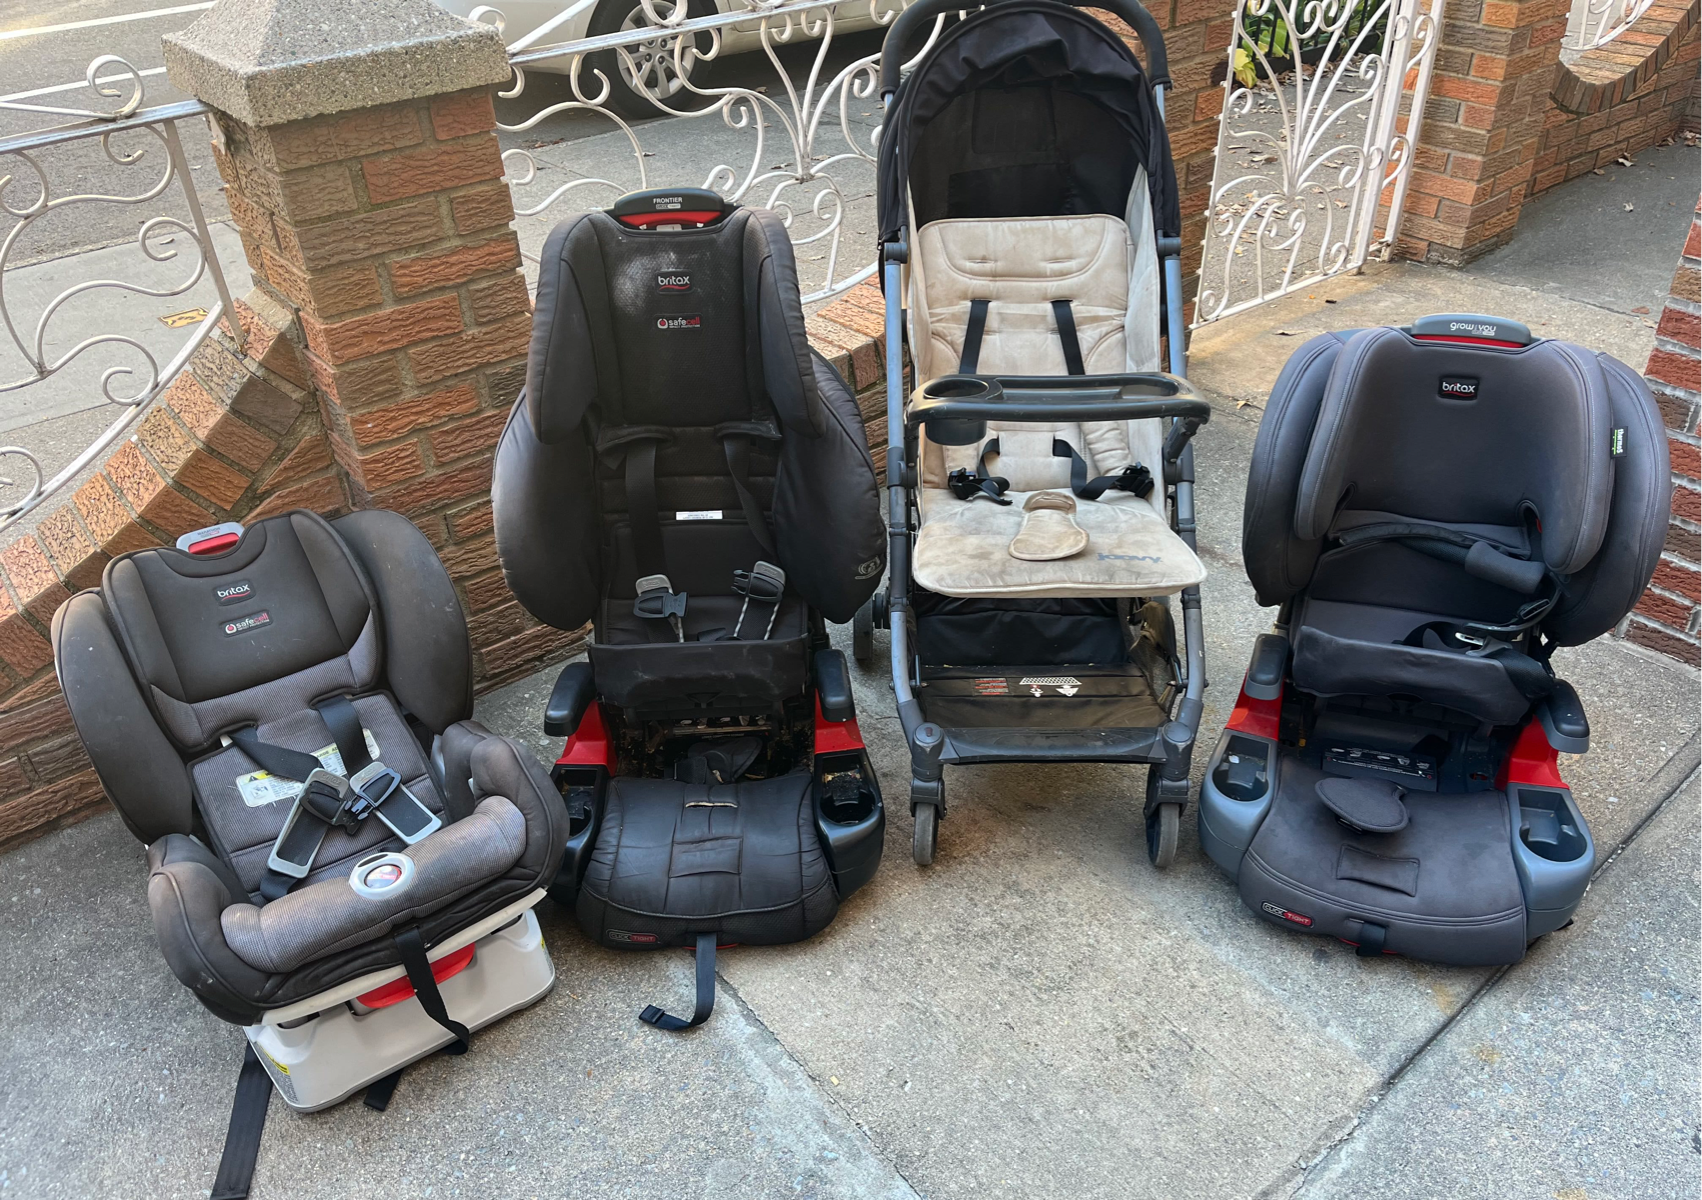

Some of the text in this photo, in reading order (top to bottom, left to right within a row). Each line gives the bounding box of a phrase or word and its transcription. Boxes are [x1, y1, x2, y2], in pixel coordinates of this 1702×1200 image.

[658, 275, 690, 286] britax
[668, 316, 701, 327] safecell
[1450, 322, 1474, 331] grow
[1478, 323, 1497, 333] you
[1442, 381, 1476, 393] britax
[217, 584, 251, 598] britax
[236, 612, 269, 628] safecell
[1287, 913, 1310, 924] TIGHT
